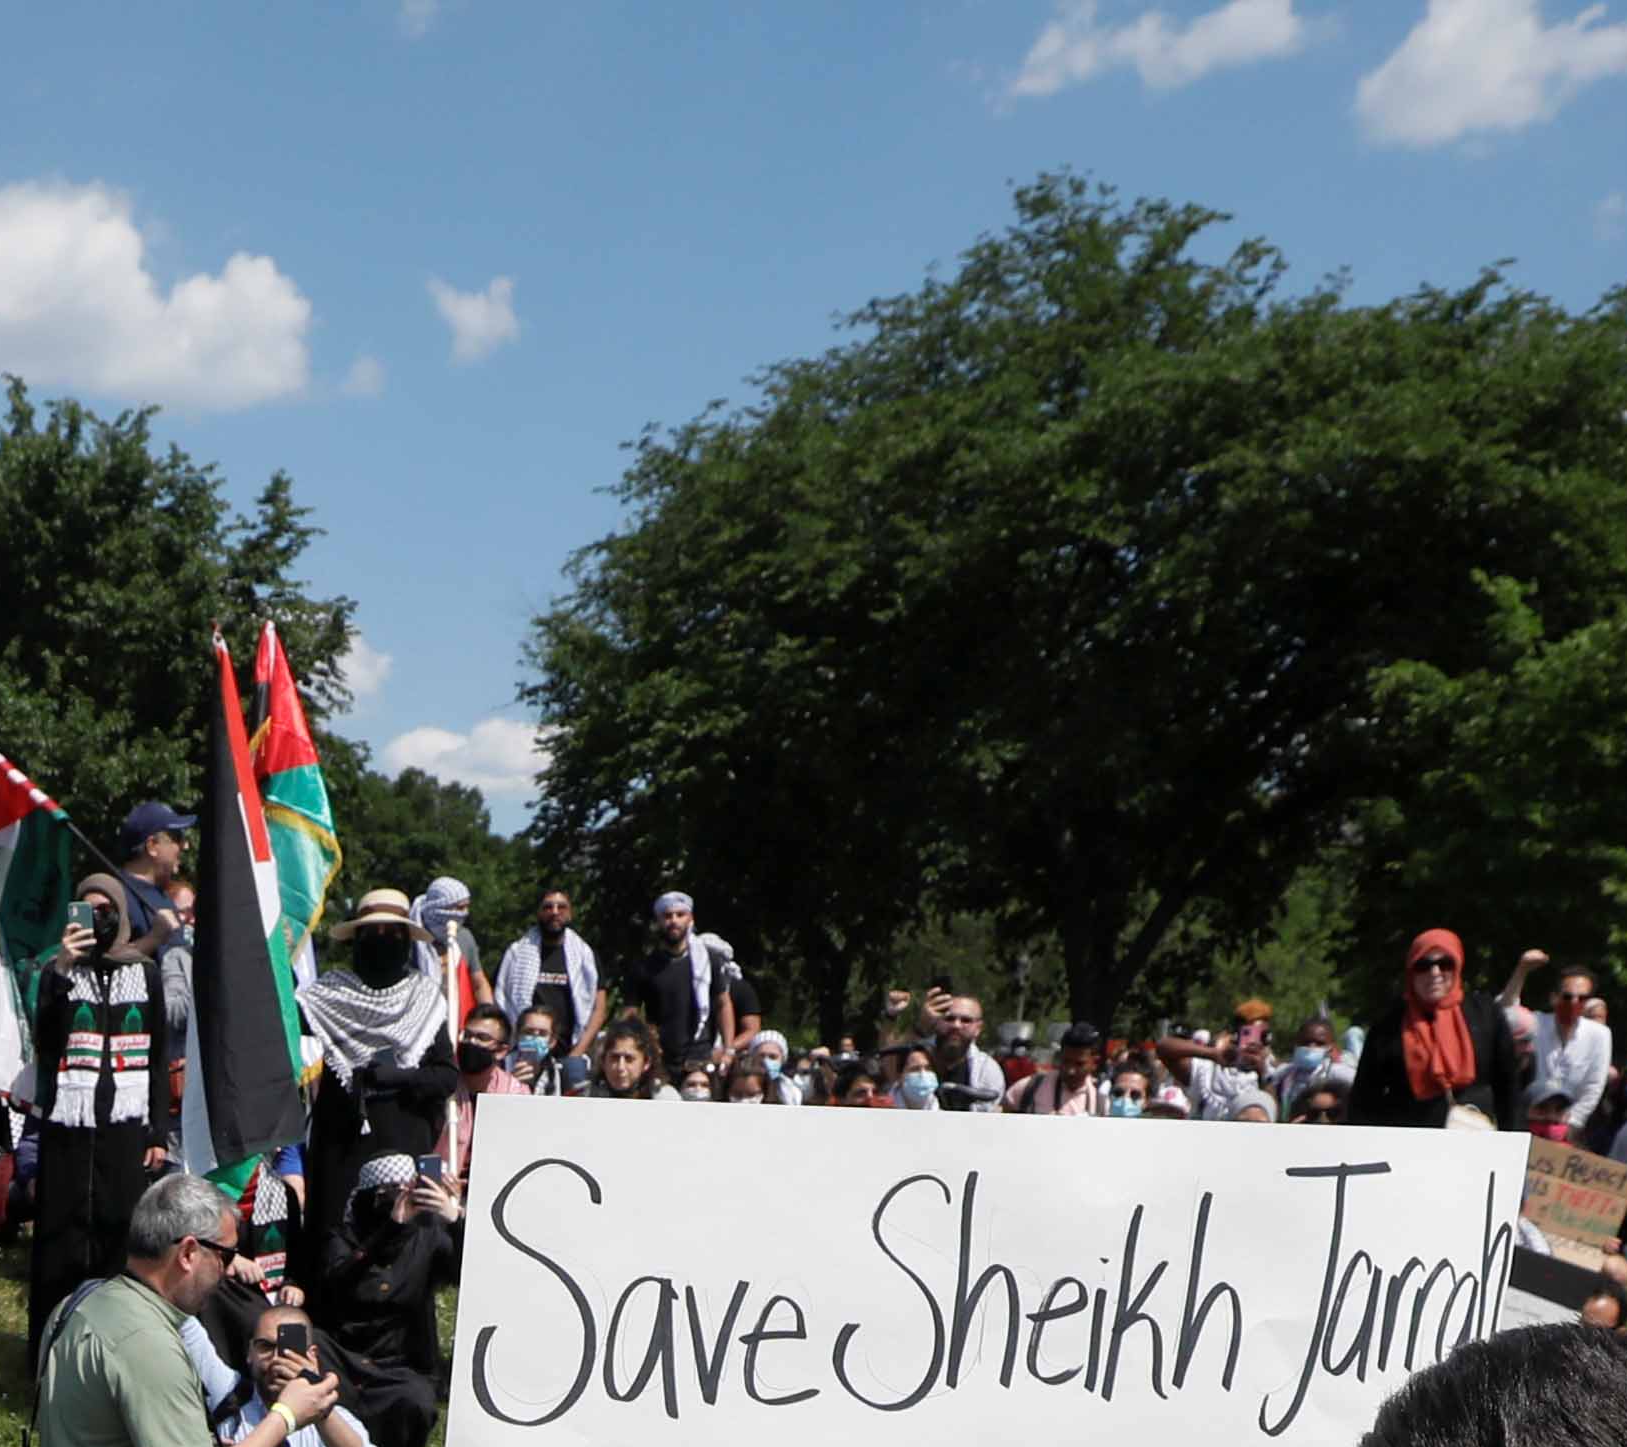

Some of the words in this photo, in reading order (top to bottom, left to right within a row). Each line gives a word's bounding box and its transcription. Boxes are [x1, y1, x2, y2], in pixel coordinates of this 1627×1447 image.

[472, 1157, 820, 1427] Save
[832, 1169, 1243, 1413] Sheikh
[1258, 1160, 1514, 1437] Jarrah
